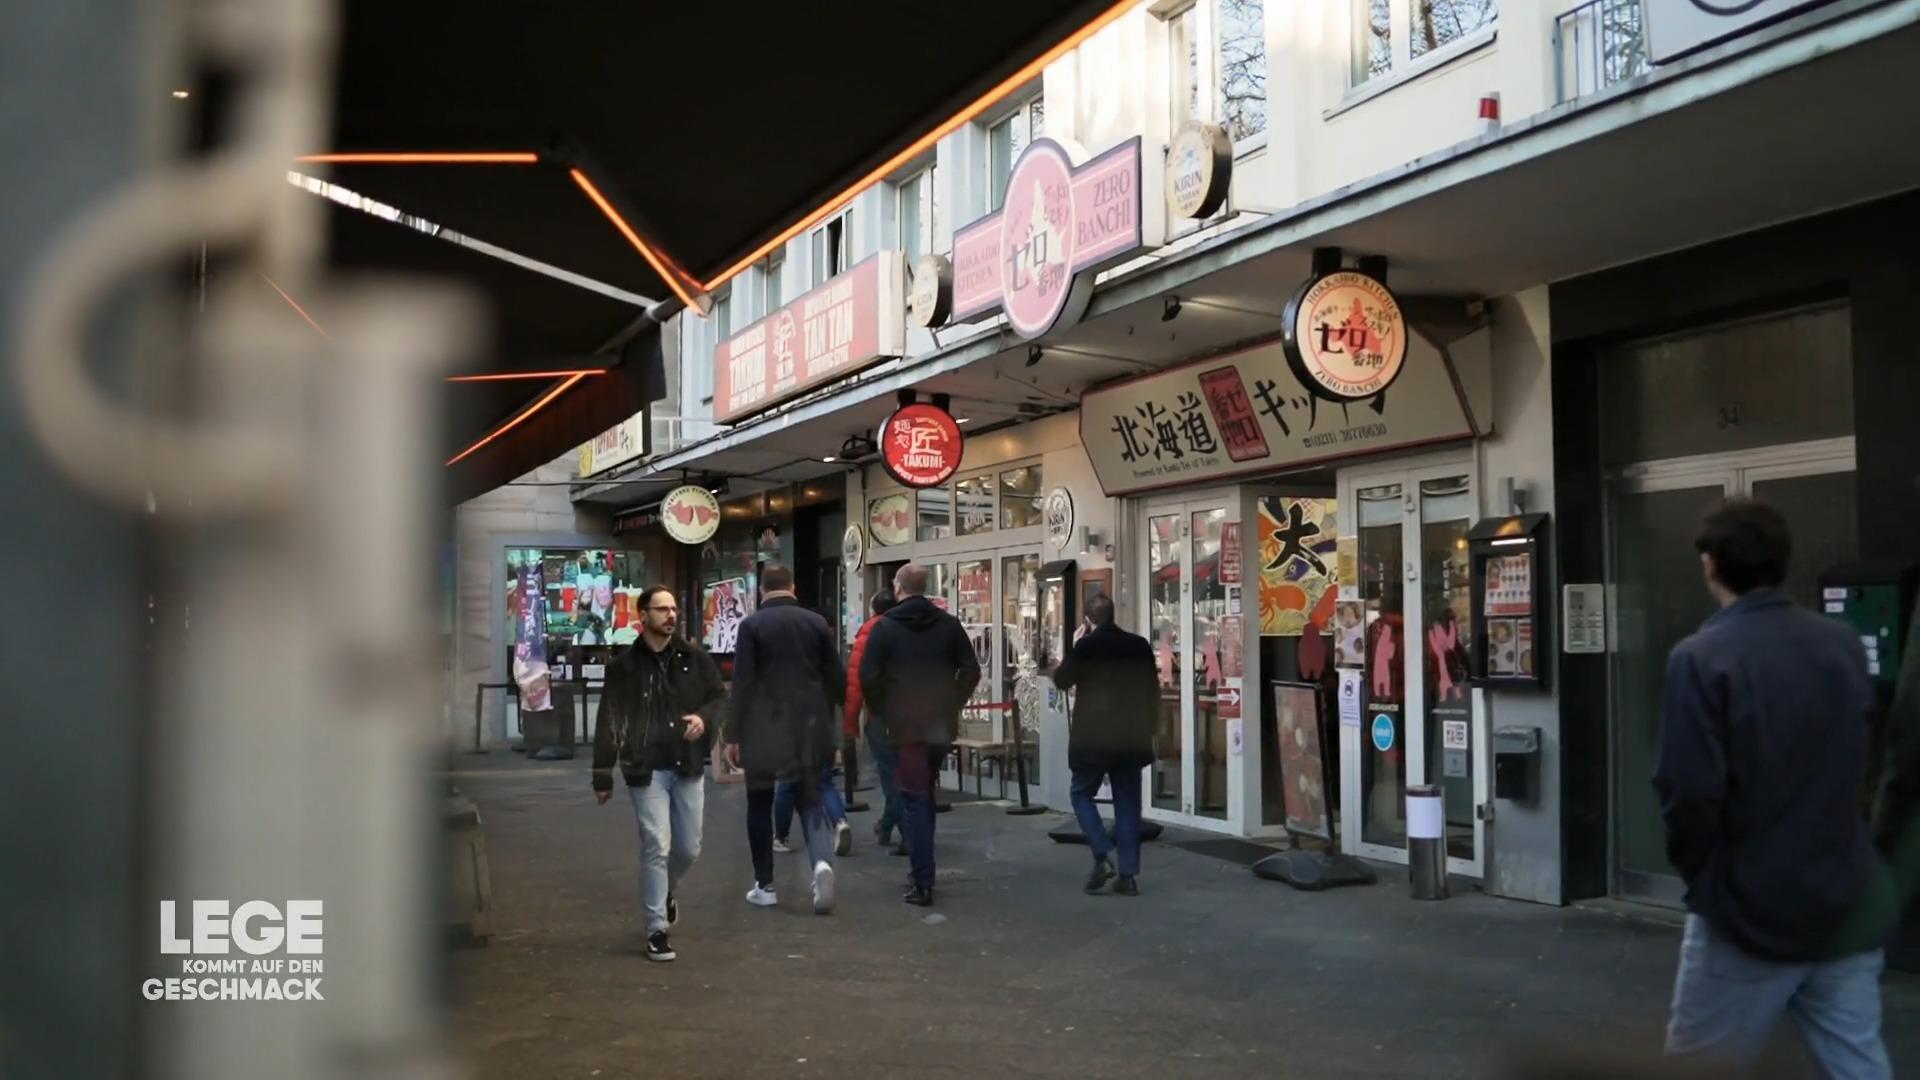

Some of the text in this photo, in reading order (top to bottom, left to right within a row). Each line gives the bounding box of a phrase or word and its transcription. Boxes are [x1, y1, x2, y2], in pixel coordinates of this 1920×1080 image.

[1093, 169, 1131, 208] ZERO
[1078, 198, 1131, 246] BANCHI
[1307, 274, 1360, 304] HOKKAIDO
[1362, 278, 1399, 320] KITCHEN
[1315, 370, 1382, 394] ZERO BANCHI
[909, 427, 942, 455] 匠
[1111, 391, 1218, 463] 北海道
[1265, 499, 1328, 576] 大
